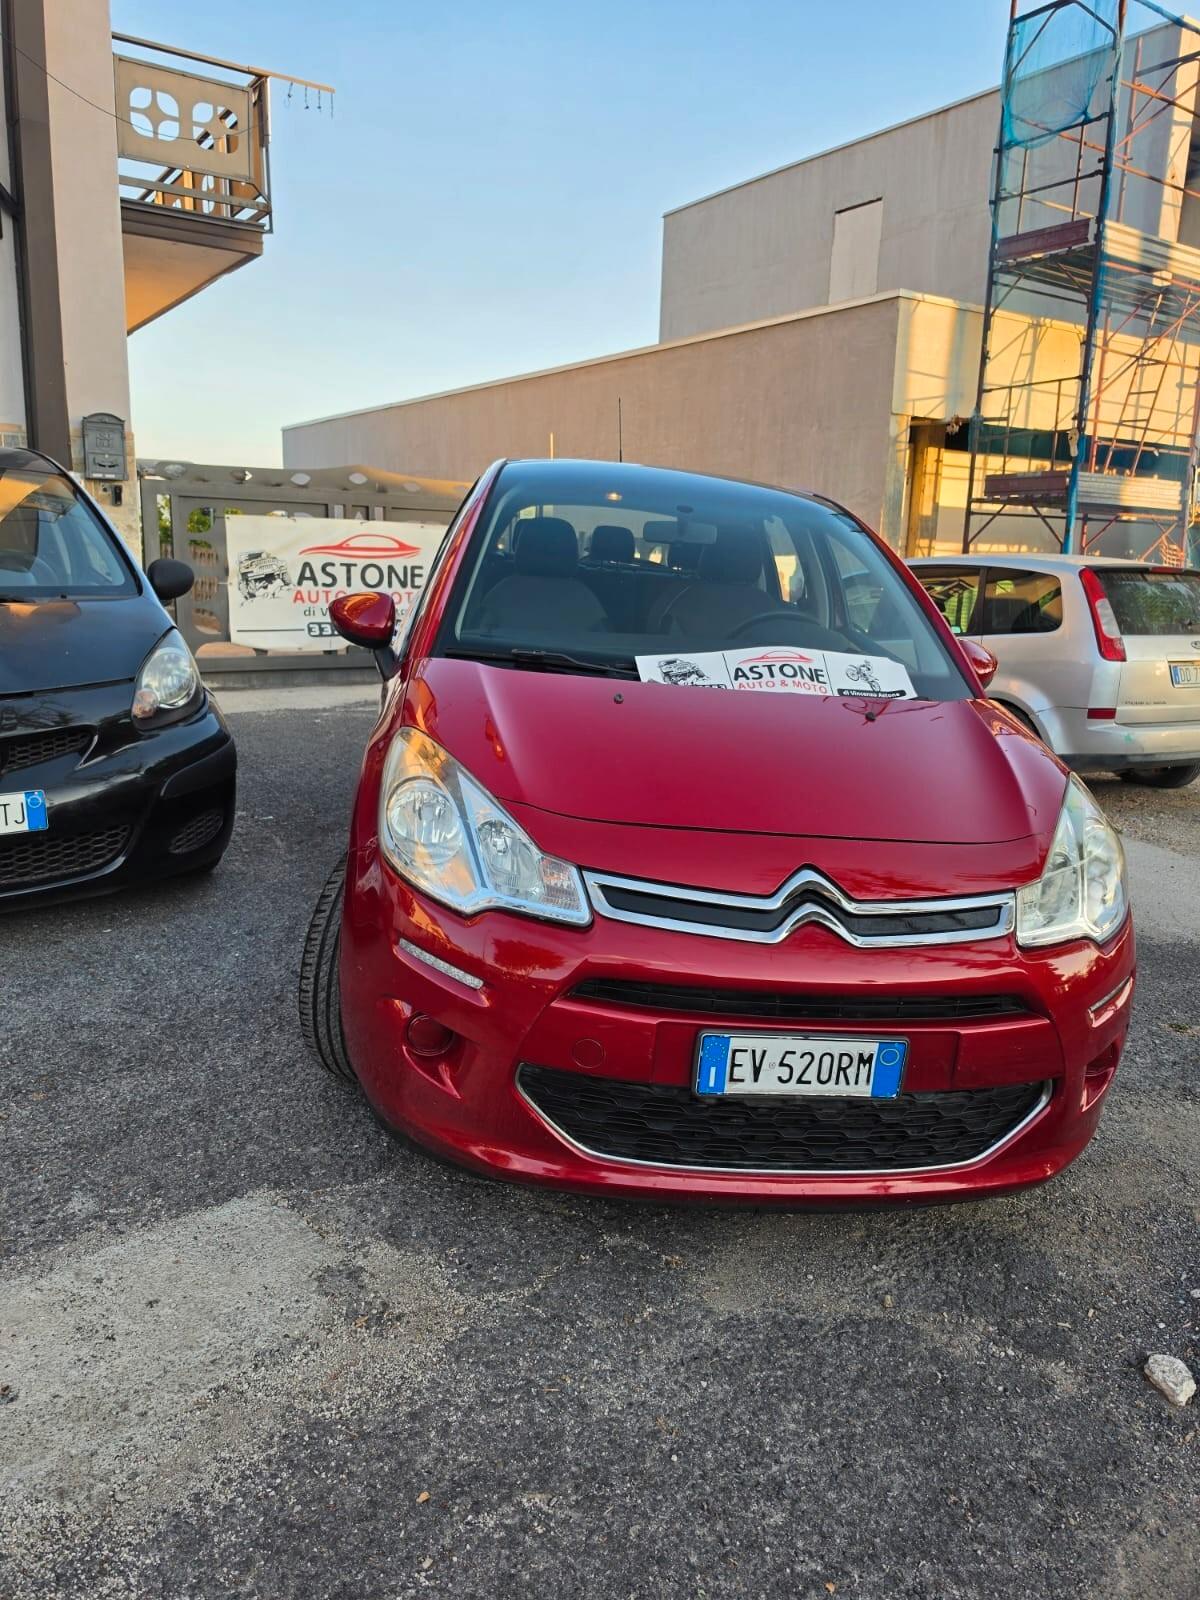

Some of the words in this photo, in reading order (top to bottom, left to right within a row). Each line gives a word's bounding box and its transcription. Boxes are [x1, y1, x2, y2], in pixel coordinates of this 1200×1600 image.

[297, 561, 424, 589] ASTONE
[733, 663, 827, 685] ASTONE
[738, 681, 775, 690] AUTO
[780, 680, 788, 688] &
[792, 681, 828, 694] MOTO
[729, 1049, 767, 1083] EV
[777, 1050, 874, 1086] 520RM
